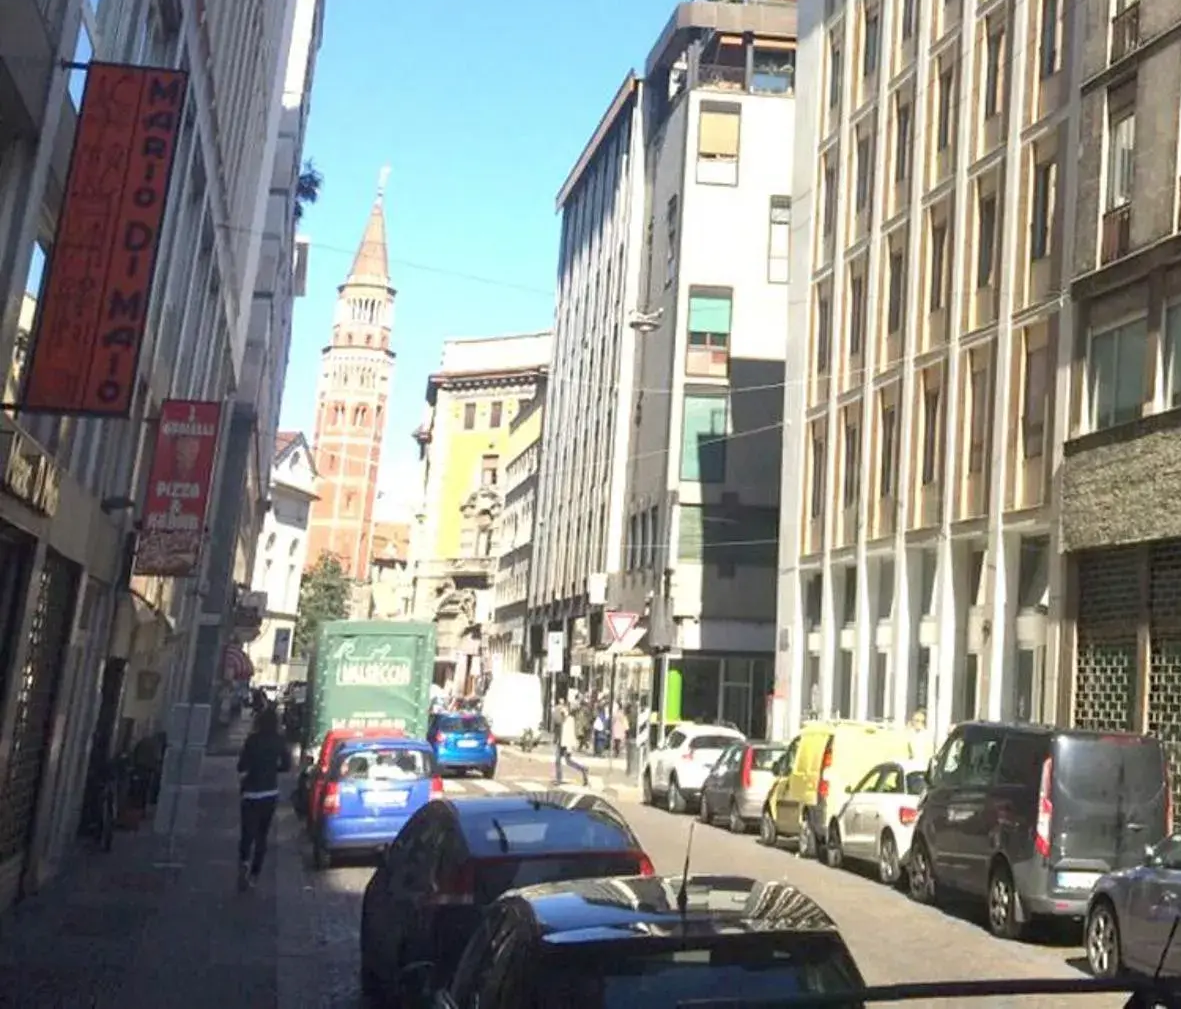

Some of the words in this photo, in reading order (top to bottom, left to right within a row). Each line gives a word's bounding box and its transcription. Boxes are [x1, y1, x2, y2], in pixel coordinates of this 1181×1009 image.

[134, 77, 180, 207] MARIO
[125, 220, 152, 278] DI
[97, 289, 142, 402] MAIO
[156, 481, 200, 498] PIZZA
